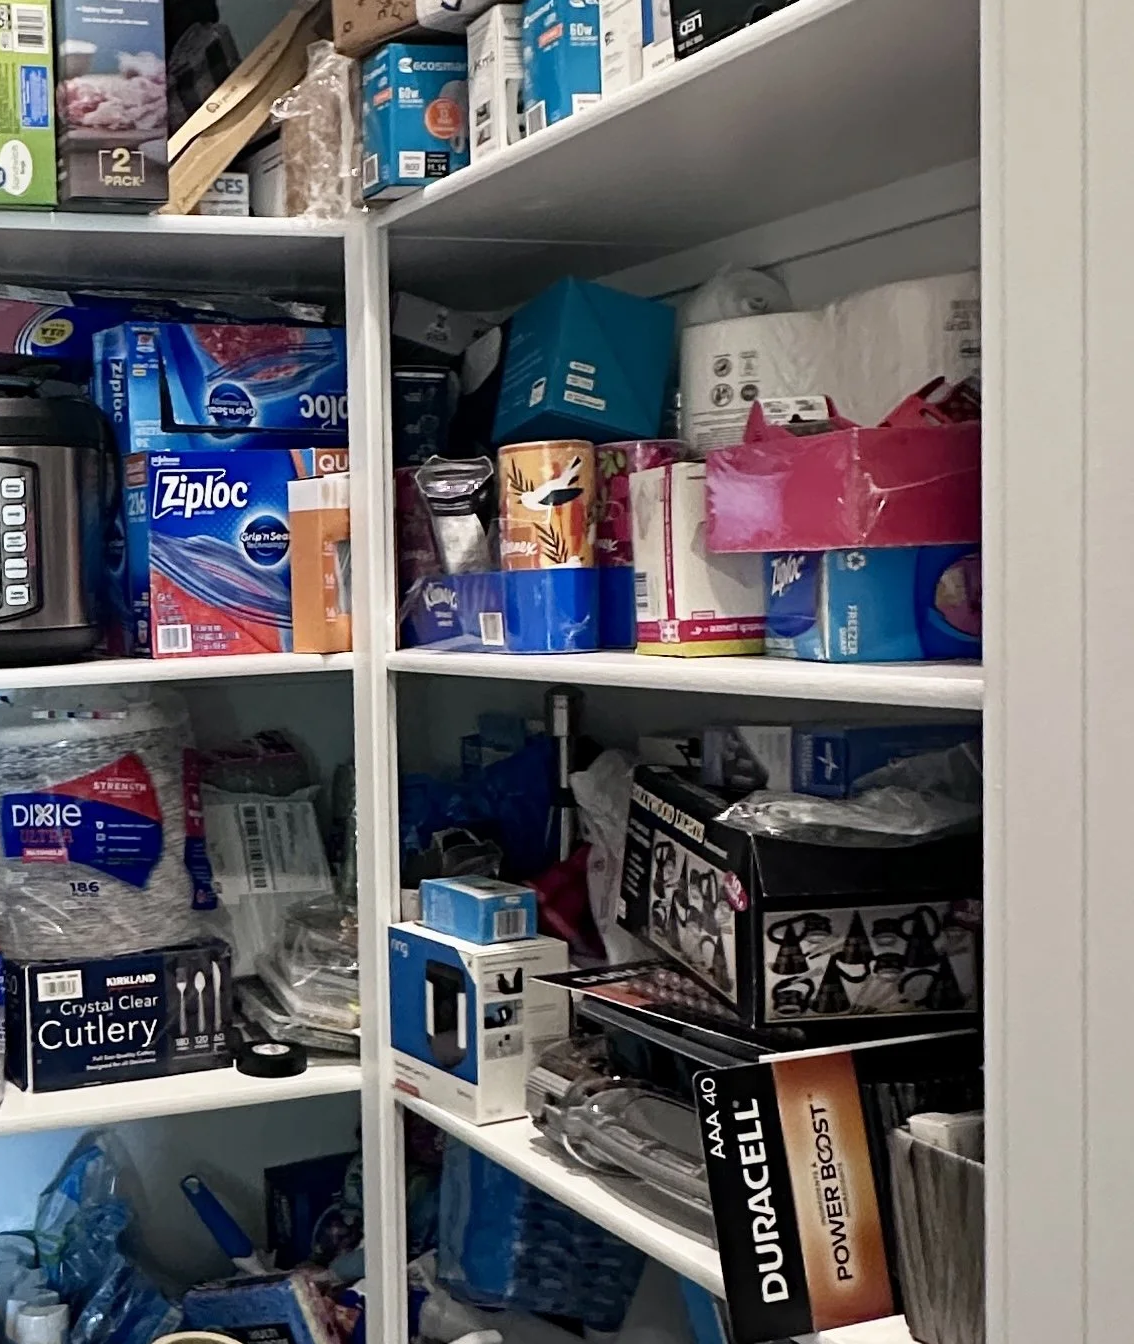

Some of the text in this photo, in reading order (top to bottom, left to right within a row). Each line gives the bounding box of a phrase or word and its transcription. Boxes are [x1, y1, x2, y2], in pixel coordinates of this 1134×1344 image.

[679, 12, 704, 37] LED
[9, 144, 22, 191] Sandwich
[111, 146, 130, 172] 2
[104, 175, 142, 188] PACK
[108, 357, 125, 423] Ziploc
[318, 454, 350, 472] QU
[161, 474, 248, 519] Ziploc
[240, 531, 269, 543] Grip'n
[847, 604, 858, 656] FREEZER
[92, 781, 147, 792] STRENGTH
[11, 803, 83, 827] DIXIE
[19, 828, 75, 845] ULTRA
[69, 881, 101, 893] 186
[390, 937, 410, 958] ring
[105, 973, 157, 987] KIRKLAND
[59, 995, 159, 1018] Crystal Clear
[38, 1014, 158, 1050] Cutlery
[700, 1076, 726, 1160] AAA 40
[735, 1098, 789, 1303] DURACELL
[809, 1103, 854, 1281] POWER BOOST
